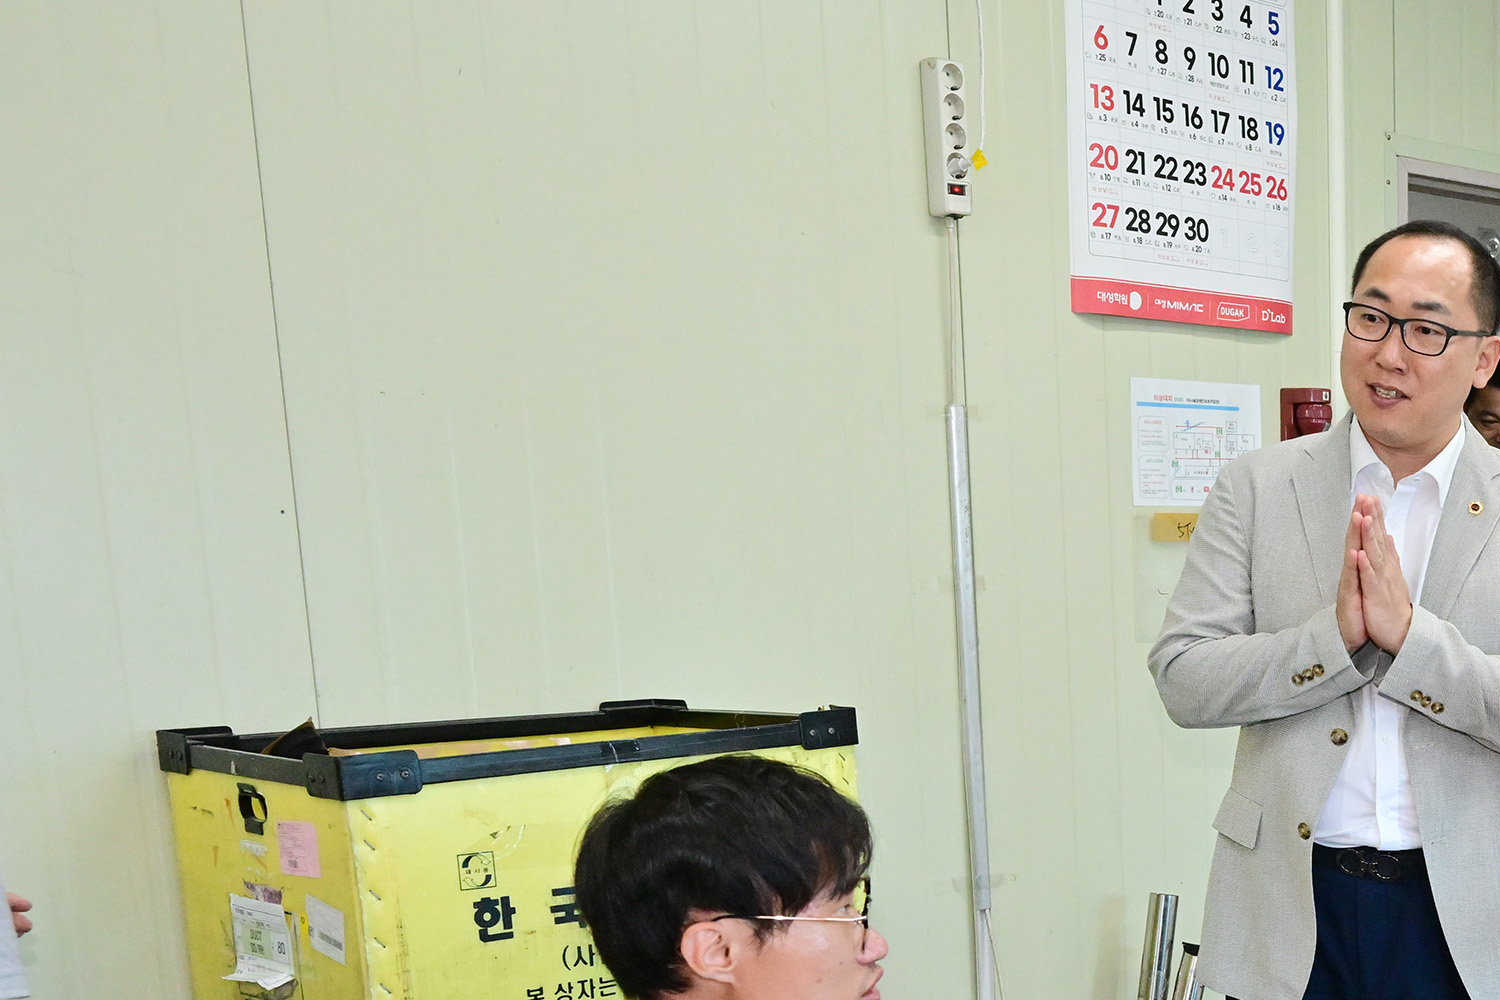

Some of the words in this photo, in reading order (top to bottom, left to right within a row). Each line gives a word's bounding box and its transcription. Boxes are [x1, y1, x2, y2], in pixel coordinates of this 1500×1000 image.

[1211, 0, 1224, 21] 3
[1240, 5, 1253, 28] 4
[1268, 11, 1280, 36] 5
[1094, 25, 1109, 50] 6
[1125, 31, 1138, 57] 7
[1155, 39, 1169, 65] 8
[1183, 46, 1196, 70] 9
[1208, 52, 1230, 79] 10
[1239, 59, 1254, 85] 11
[1264, 66, 1284, 92] 12
[1090, 83, 1115, 111] 13
[1122, 90, 1145, 117] 14
[1153, 96, 1175, 123] 15
[1182, 103, 1204, 130] 16
[1210, 109, 1230, 135] 17
[1238, 115, 1259, 141] 18
[1265, 121, 1285, 146] 19
[1089, 142, 1119, 171] 20
[1125, 149, 1146, 176] 21
[1153, 154, 1179, 182] 22
[1182, 160, 1207, 187] 23
[1210, 165, 1235, 192] 24
[1238, 170, 1262, 197] 25
[1266, 175, 1288, 201] 26
[1091, 202, 1120, 229] 27
[1125, 207, 1151, 234] 28
[1155, 212, 1180, 238] 29
[1184, 216, 1209, 243] 30
[1096, 290, 1128, 306] 대성학원
[1220, 306, 1245, 318] DUGAK
[473, 895, 516, 943] 한
